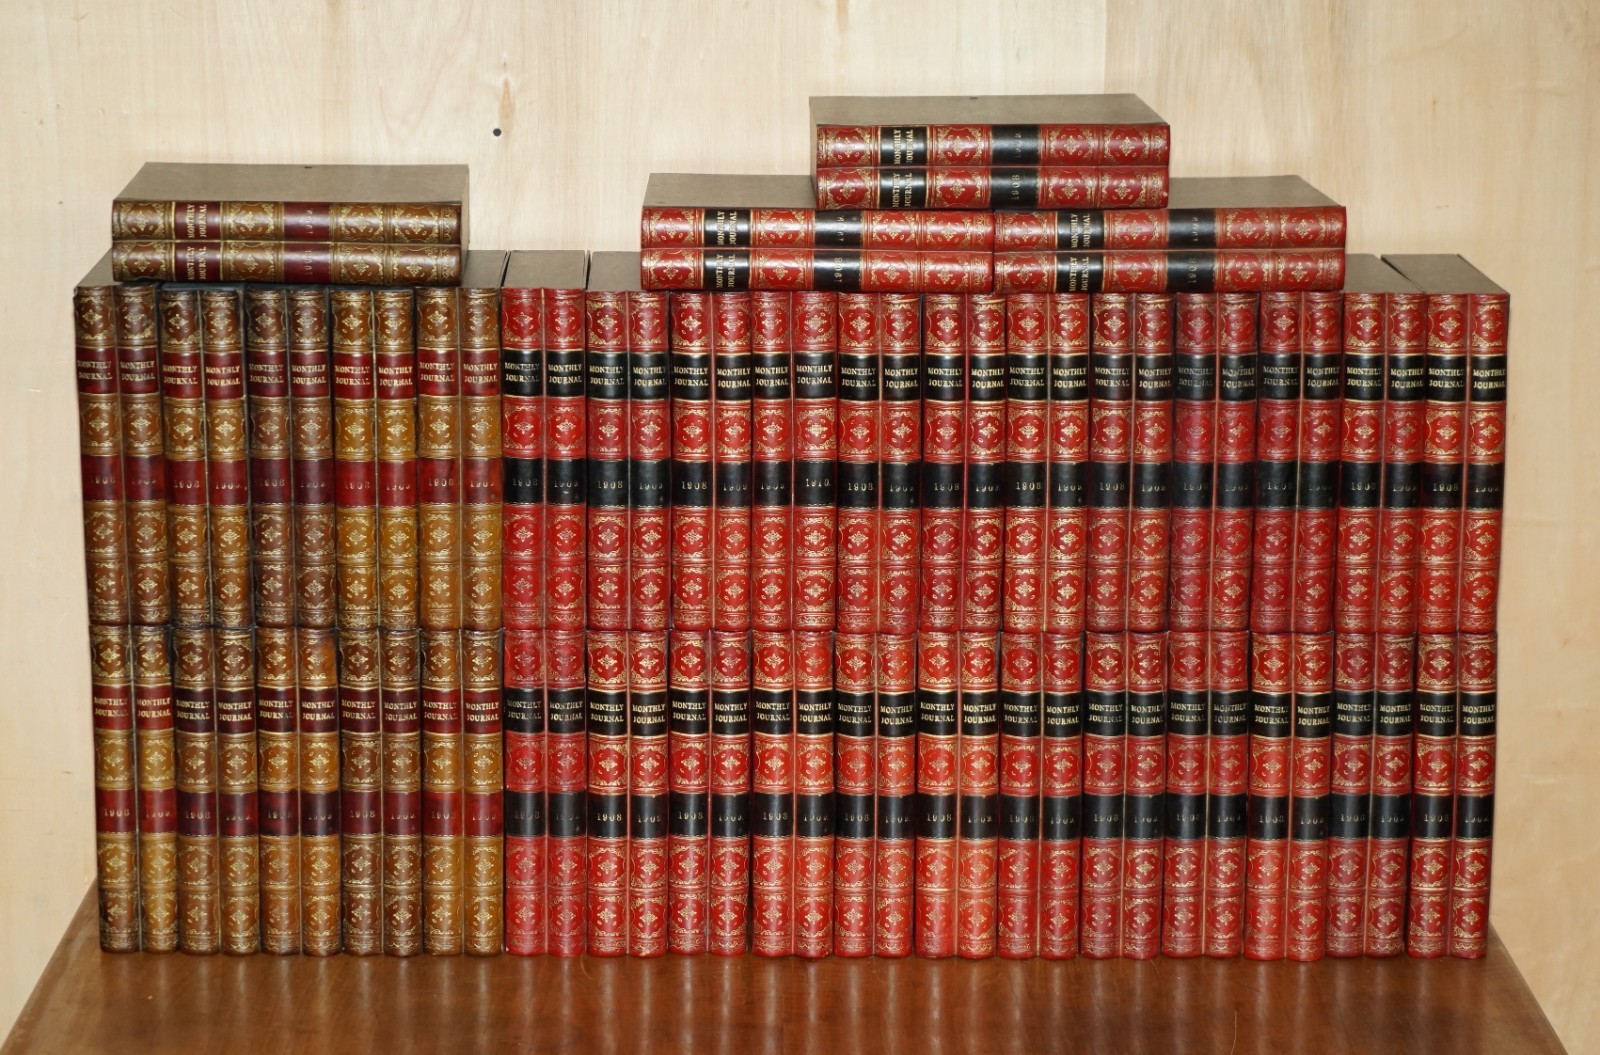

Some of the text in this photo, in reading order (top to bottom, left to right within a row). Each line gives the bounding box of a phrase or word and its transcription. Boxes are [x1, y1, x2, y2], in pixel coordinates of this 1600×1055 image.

[120, 361, 154, 369] MONTHLY
[163, 365, 197, 373] MONTHLY
[292, 364, 326, 372] MONTHLY
[419, 362, 454, 370] MONTHLY
[464, 364, 497, 372] MONTHLY
[548, 364, 582, 372] MONTHLY
[206, 366, 240, 374] MONTHLY
[335, 365, 370, 374] MONTHLY
[379, 366, 413, 375] MONTHLY
[589, 366, 624, 374] MONTHLY
[633, 366, 666, 375] MONTHLY
[674, 367, 708, 375] MONTHLY
[717, 368, 750, 376] MONTHLY
[755, 366, 788, 375] MONTHLY
[841, 367, 876, 375] MONTHLY
[885, 368, 918, 376] MONTHLY
[928, 367, 962, 376] MONTHLY
[971, 368, 1004, 377] MONTHLY
[1009, 367, 1045, 375] MONTHLY
[1053, 368, 1087, 377] MONTHLY
[1094, 368, 1129, 376] MONTHLY
[1139, 368, 1171, 376] MONTHLY
[1307, 368, 1339, 376] MONTHLY
[1390, 368, 1424, 376] MONTHLY
[1429, 368, 1463, 376] MONTHLY
[1473, 369, 1506, 377] MONTHLY
[122, 372, 155, 381] JOURNAL
[420, 374, 455, 382] JOURNAL
[465, 375, 497, 383] JOURNAL
[797, 376, 832, 384] JOURNAL
[207, 378, 240, 386] JOURNAL
[336, 377, 370, 385] JOURNAL
[379, 378, 413, 386] JOURNAL
[590, 377, 624, 385] JOURNAL
[633, 378, 666, 386] JOURNAL
[674, 378, 708, 386] JOURNAL
[718, 379, 751, 387] JOURNAL
[756, 378, 788, 386] JOURNAL
[886, 379, 918, 388] JOURNAL
[929, 379, 962, 387] JOURNAL
[972, 380, 1004, 388] JOURNAL
[1054, 379, 1086, 388] JOURNAL
[1095, 379, 1130, 387] JOURNAL
[1139, 379, 1171, 388] JOURNAL
[1307, 379, 1339, 387] JOURNAL
[1347, 379, 1381, 387] JOURNAL
[1391, 380, 1424, 388] JOURNAL
[1429, 379, 1464, 387] JOURNAL
[1473, 380, 1506, 388] JOURNAL
[597, 481, 623, 489] 1908
[681, 481, 708, 490] 1908
[847, 482, 874, 491] 1908
[1016, 482, 1042, 490] 1908
[1432, 483, 1458, 491] 1908
[137, 697, 171, 705] MONTHLY
[176, 700, 210, 708] MONTHLY
[302, 701, 335, 709] MONTHLY
[341, 700, 375, 709] MONTHLY
[672, 701, 706, 709] MONTHLY
[218, 701, 251, 710] MONTHLY
[384, 701, 417, 710] MONTHLY
[466, 702, 499, 710] MONTHLY
[550, 701, 583, 710] MONTHLY
[590, 703, 624, 711] MONTHLY
[632, 704, 666, 712] MONTHLY
[756, 701, 790, 710] MONTHLY
[798, 703, 832, 711] MONTHLY
[838, 703, 871, 712] MONTHLY
[880, 705, 913, 713] MONTHLY
[920, 702, 955, 711] MONTHLY
[963, 703, 996, 712] MONTHLY
[1003, 703, 1038, 712] MONTHLY
[1047, 705, 1079, 714] MONTHLY
[1088, 703, 1123, 712] MONTHLY
[1131, 705, 1164, 713] MONTHLY
[1171, 702, 1205, 710] MONTHLY
[1214, 703, 1247, 712] MONTHLY
[1254, 704, 1289, 712] MONTHLY
[1297, 705, 1330, 714] MONTHLY
[1337, 703, 1372, 711] MONTHLY
[1379, 704, 1411, 712] MONTHLY
[1420, 704, 1454, 712] MONTHLY
[1462, 705, 1495, 713] MONTHLY
[138, 710, 171, 718] JOURNAL
[177, 712, 210, 720] JOURNAL
[220, 713, 252, 721] JOURNAL
[303, 712, 335, 720] JOURNAL
[385, 712, 417, 721] JOURNAL
[467, 713, 499, 721] JOURNAL
[551, 713, 583, 721] JOURNAL
[673, 713, 706, 721] JOURNAL
[715, 714, 747, 722] JOURNAL
[757, 713, 790, 721] JOURNAL
[921, 713, 955, 721] JOURNAL
[1171, 714, 1205, 722] JOURNAL
[1214, 714, 1246, 722] JOURNAL
[1337, 714, 1371, 722] JOURNAL
[591, 714, 624, 723] JOURNAL
[633, 715, 665, 723] JOURNAL
[799, 714, 832, 723] JOURNAL
[839, 714, 871, 723] JOURNAL
[881, 716, 913, 725] JOURNAL
[964, 715, 996, 723] JOURNAL
[1004, 715, 1038, 723] JOURNAL
[1047, 716, 1079, 724] JOURNAL
[1089, 715, 1123, 723] JOURNAL
[1131, 716, 1163, 724] JOURNAL
[1255, 716, 1289, 724] JOURNAL
[1298, 717, 1329, 725] JOURNAL
[1420, 715, 1454, 723] JOURNAL
[1463, 716, 1495, 724] JOURNAL
[597, 813, 622, 822] 1908
[762, 812, 788, 820] 1908
